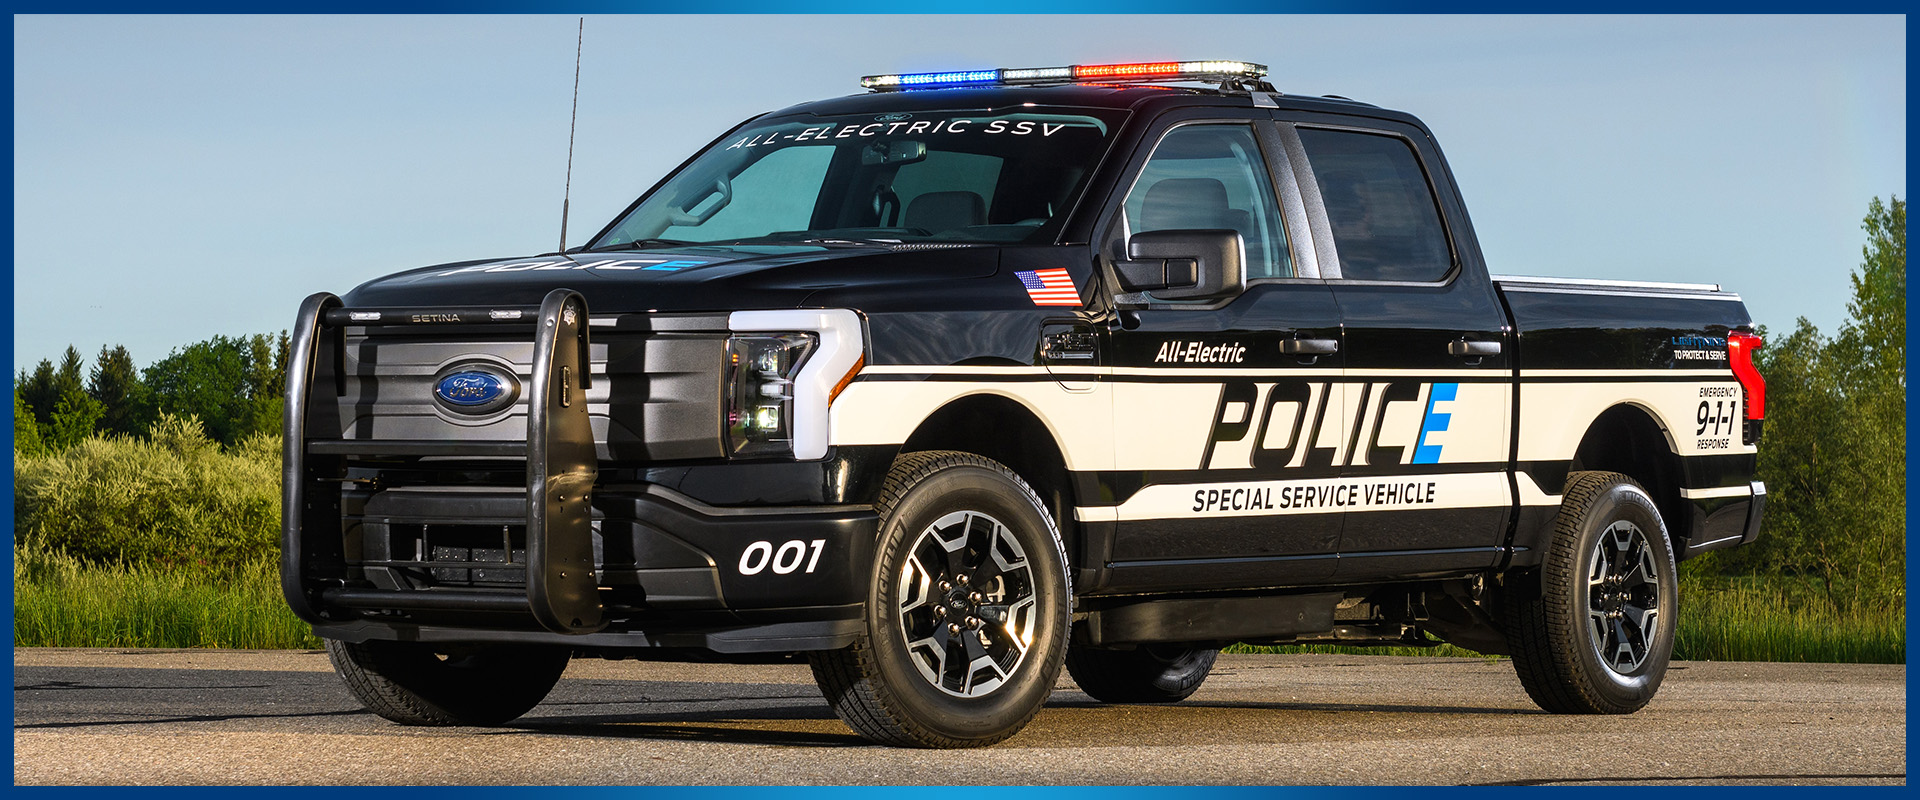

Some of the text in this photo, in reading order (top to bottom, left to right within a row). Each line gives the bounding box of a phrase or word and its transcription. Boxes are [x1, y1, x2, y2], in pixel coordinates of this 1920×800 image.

[725, 120, 1065, 151] ALL-ELECTRIC SSV
[438, 260, 708, 276] POLICE
[412, 313, 460, 323] SETINA
[1155, 341, 1246, 363] All-Electric
[1674, 350, 1682, 360] TO
[1682, 350, 1705, 360] PROTECT
[1710, 350, 1726, 360] SERVE
[449, 378, 488, 398] Ford
[1699, 387, 1738, 398] EMERGENCY
[1198, 382, 1458, 470] POLICE
[1696, 400, 1736, 436] 9-1-1
[1697, 438, 1730, 450] RESPONSE
[1192, 482, 1436, 512] SPECIAL SERVICE VEHICLE
[738, 539, 826, 576] 001
[878, 524, 905, 620] MICHELIN
